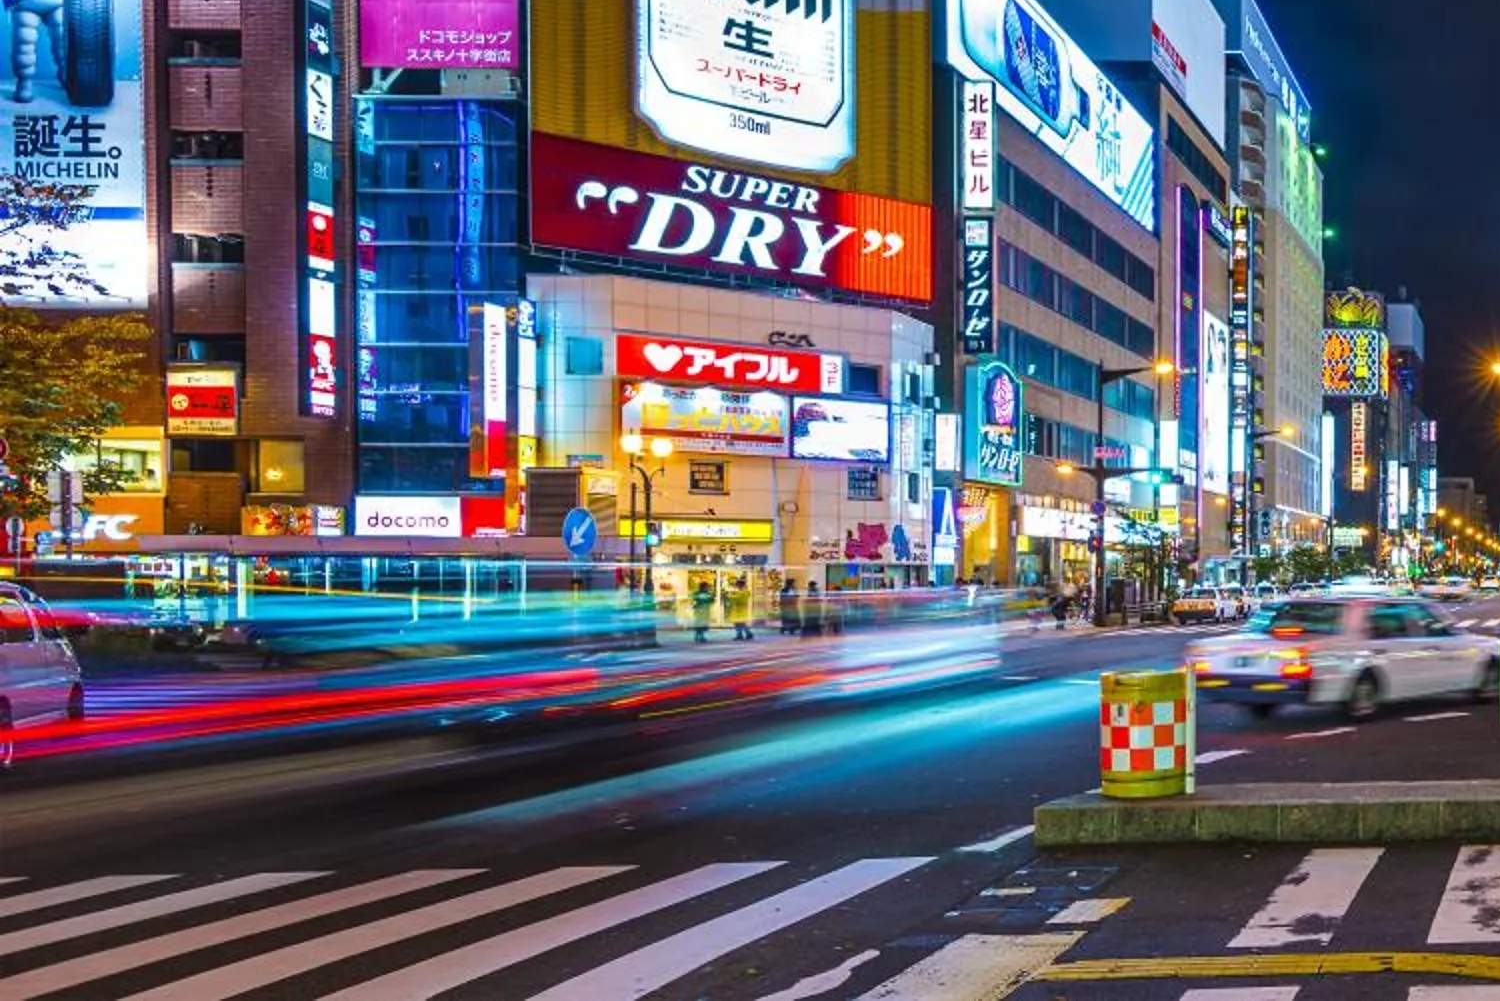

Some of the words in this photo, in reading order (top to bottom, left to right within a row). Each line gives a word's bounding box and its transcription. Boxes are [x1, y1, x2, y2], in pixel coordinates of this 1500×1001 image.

[418, 30, 511, 45] ドコモショップ
[721, 17, 775, 60] 生
[696, 58, 803, 96] スーパードライ
[13, 114, 122, 160] 誕生。
[729, 112, 771, 136] 350ml
[968, 93, 990, 195] 北星ビル
[15, 161, 119, 180] MICHELIN
[681, 165, 820, 213] SUPER
[683, 344, 800, 384] アイフル
[366, 510, 450, 530] docomo
